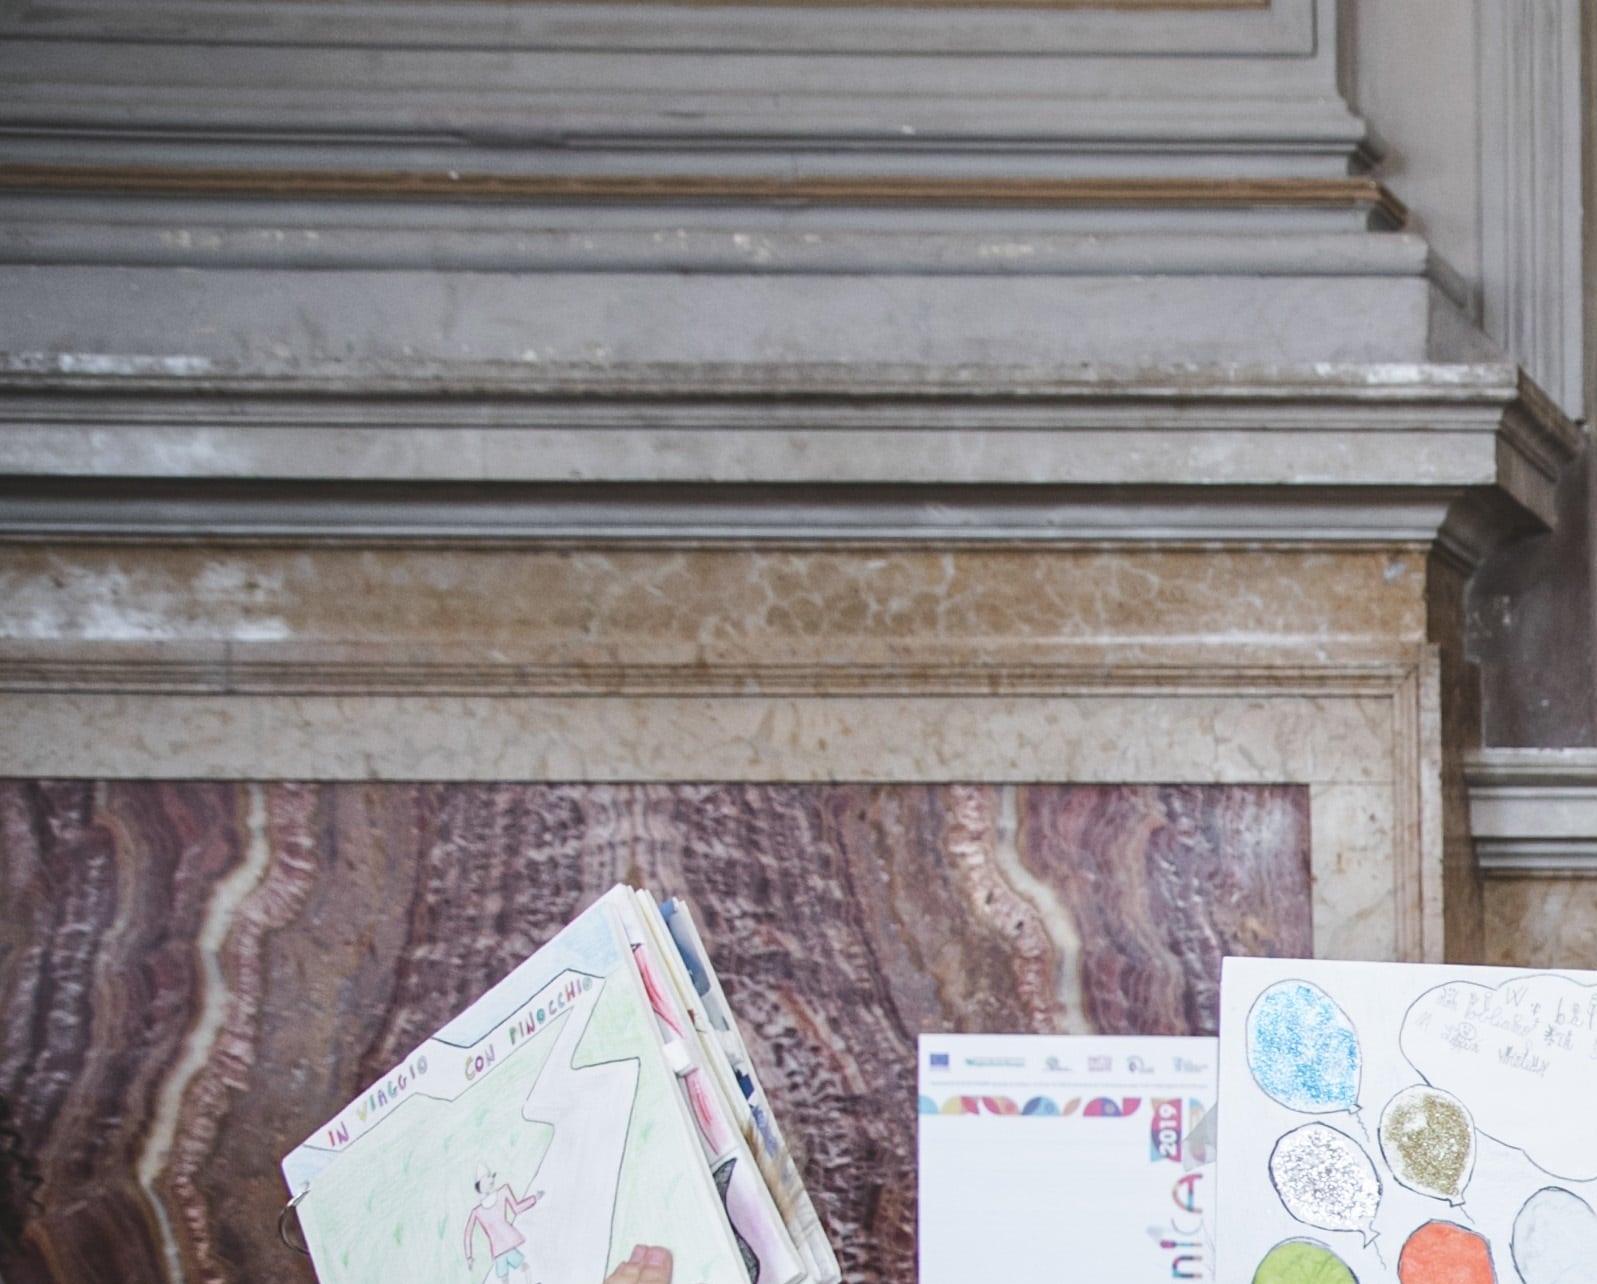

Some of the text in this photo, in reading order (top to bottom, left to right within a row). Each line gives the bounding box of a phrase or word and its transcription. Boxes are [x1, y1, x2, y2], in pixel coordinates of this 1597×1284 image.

[327, 976, 594, 1147] IN VIAGGIO CON PINOCCHIO
[1159, 1105, 1177, 1158] 2019
